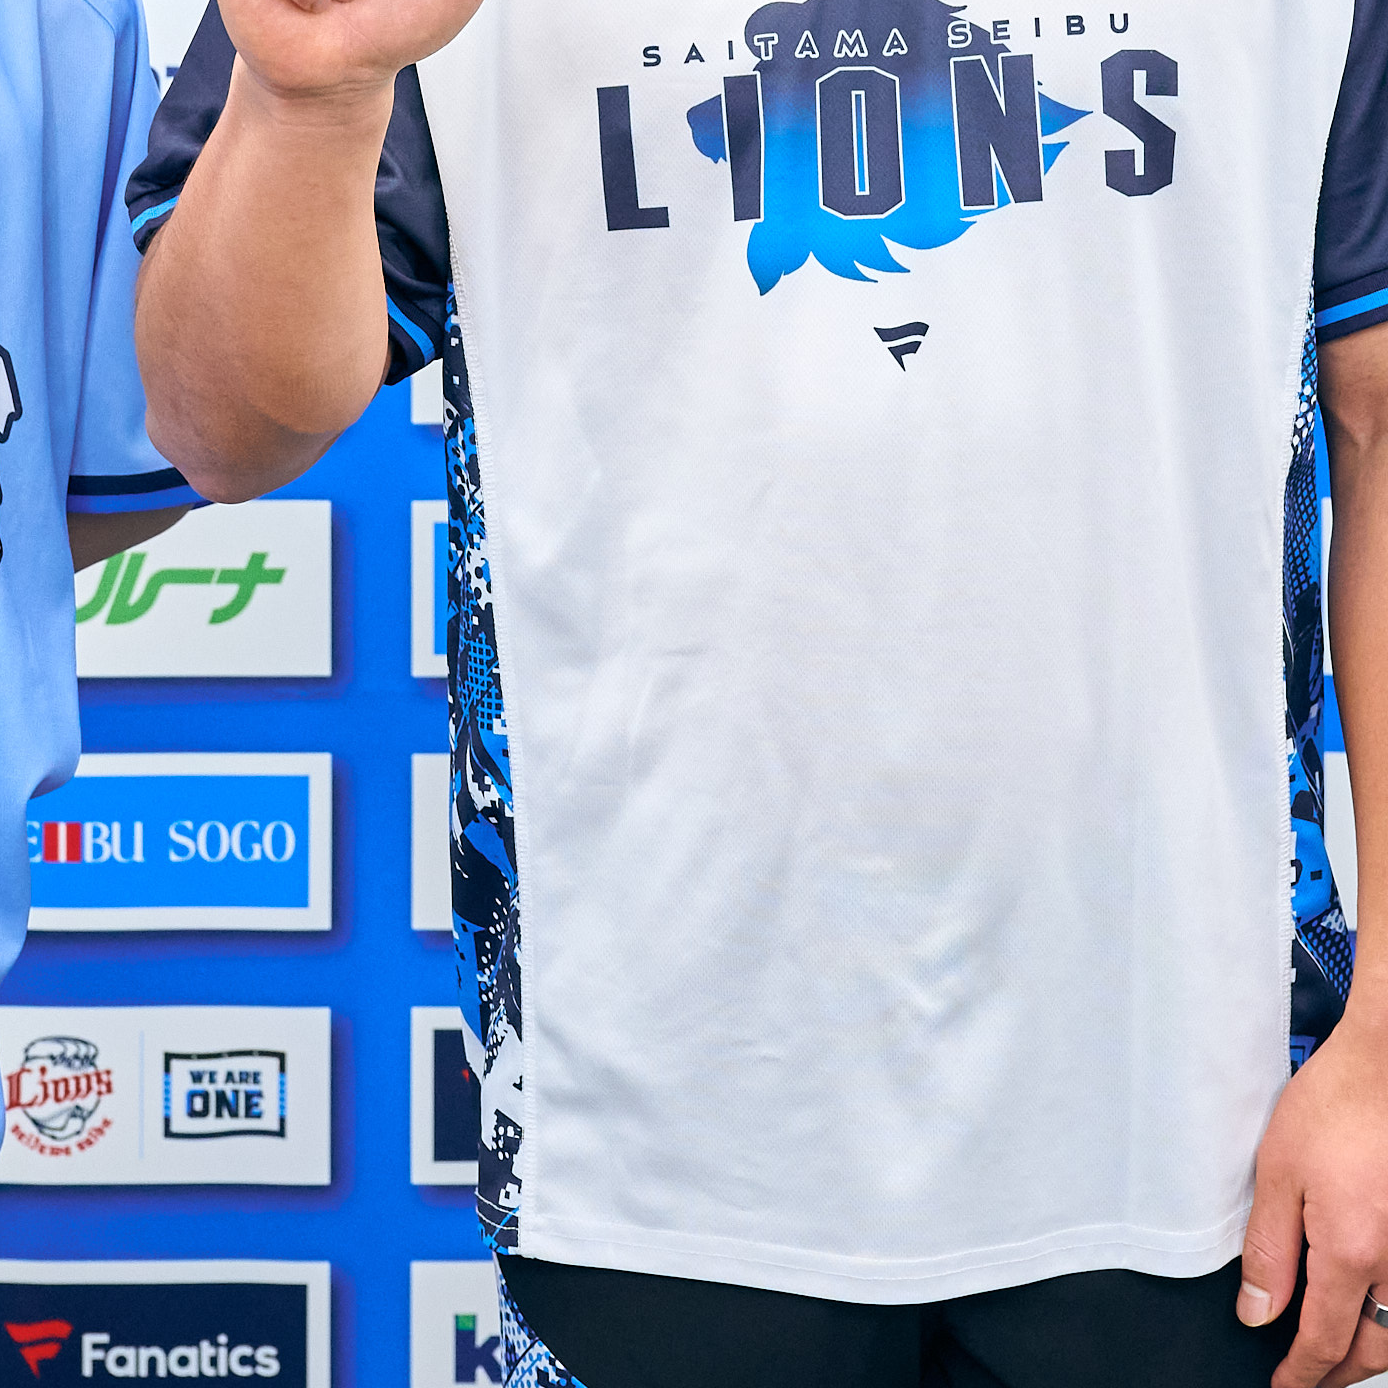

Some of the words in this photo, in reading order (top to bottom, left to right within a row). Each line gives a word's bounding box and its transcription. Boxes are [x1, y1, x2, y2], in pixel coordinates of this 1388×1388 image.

[642, 29, 909, 68] SAITAMA
[947, 12, 1130, 49] SEIBU
[596, 49, 1179, 231] LIONS
[76, 552, 286, 625] ルーナ
[169, 821, 295, 862] SOGO
[4, 1068, 113, 1112] Lions
[190, 1071, 217, 1084] WE
[225, 1071, 261, 1085] ARE
[187, 1089, 263, 1119] ONE
[82, 1333, 280, 1378] Fanatics
